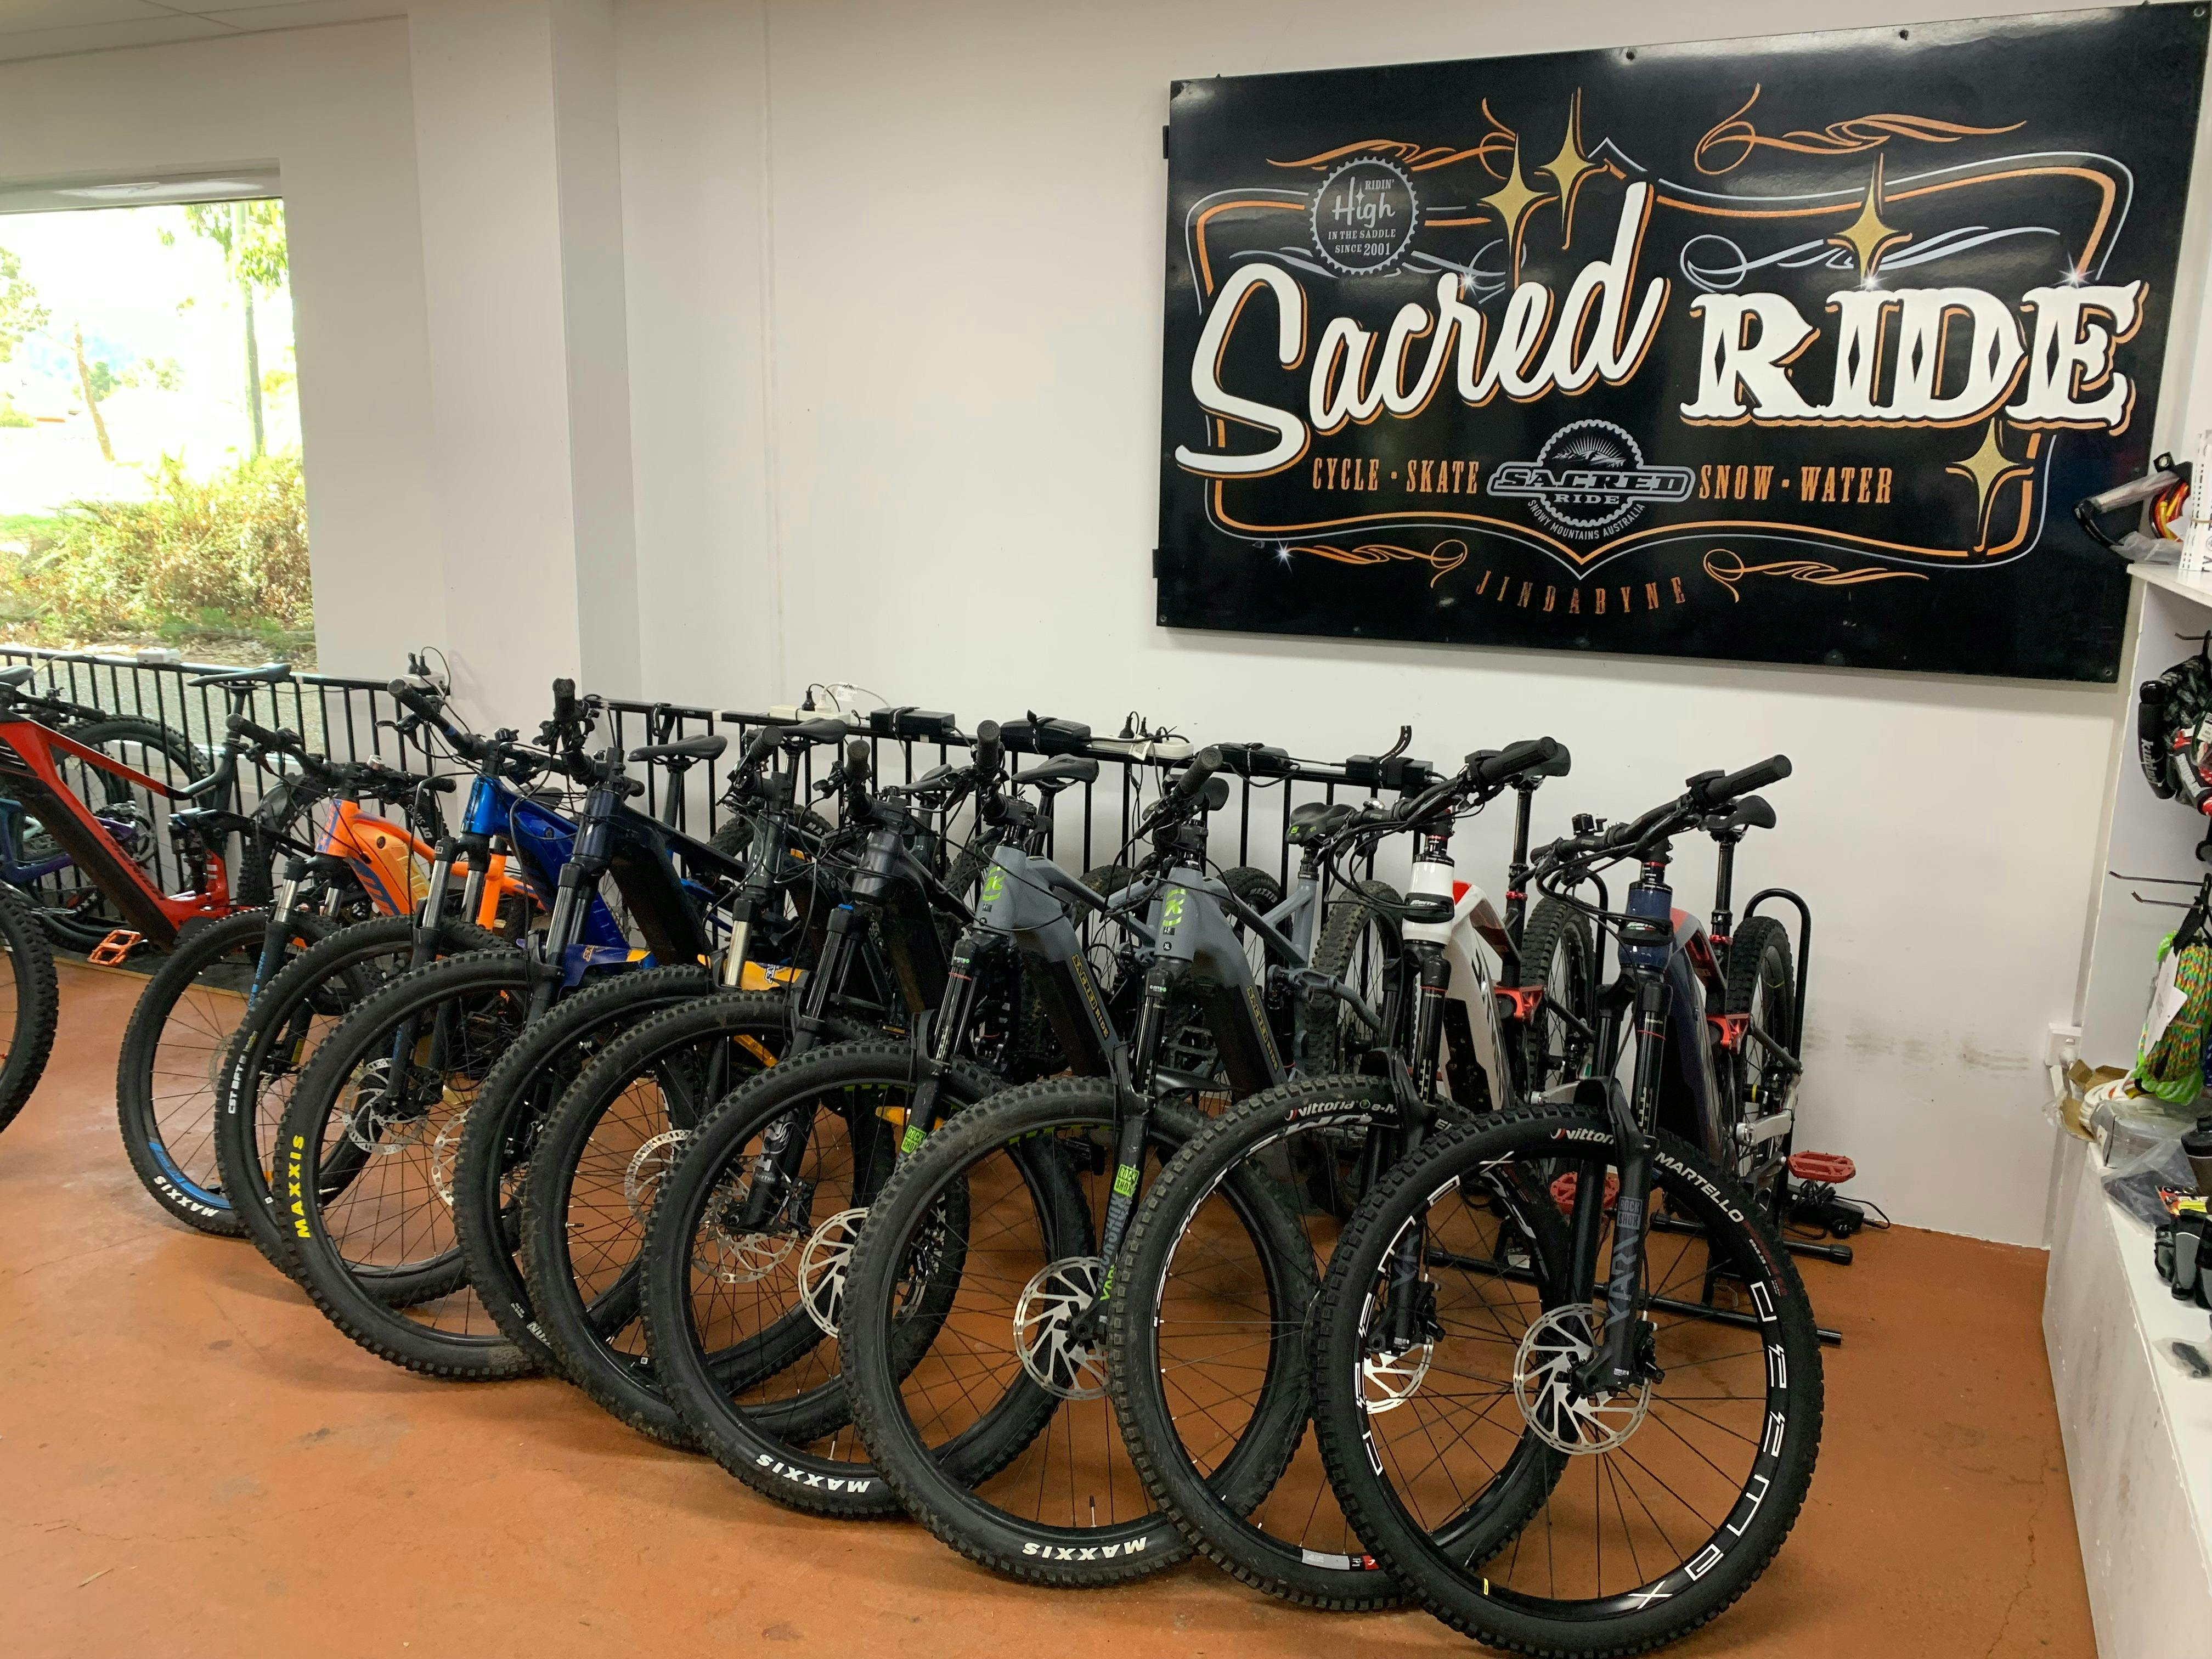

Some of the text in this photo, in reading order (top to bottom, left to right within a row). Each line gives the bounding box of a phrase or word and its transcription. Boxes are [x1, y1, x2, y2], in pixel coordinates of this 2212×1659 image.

[1331, 176, 1396, 229] High
[1364, 178, 1395, 190] RIDIN'
[1328, 228, 1396, 240] IN THE SADDLE
[1334, 242, 1390, 256] SINCE 2001
[1175, 182, 2146, 476] Sacred RIDE
[1312, 457, 1480, 494] CYCLE SKATE
[1498, 470, 1685, 492] SACRED
[1699, 464, 1893, 504] SNOW WATER
[1554, 493, 1620, 505] RIDE
[1527, 499, 1646, 540] SNOWY MOUNTAINS AUSTRALIA
[1476, 570, 1686, 615] JINDABYNE
[153, 1175, 220, 1217] MAXXIS
[288, 1134, 311, 1238] MAXXIS
[1654, 1152, 1745, 1223] MARTELLO
[1618, 1213, 1639, 1227] SHOX
[1620, 1199, 1641, 1214] ROCK
[755, 1454, 871, 1493] MAXXIS
[1022, 1536, 1147, 1555] MAXXIS
